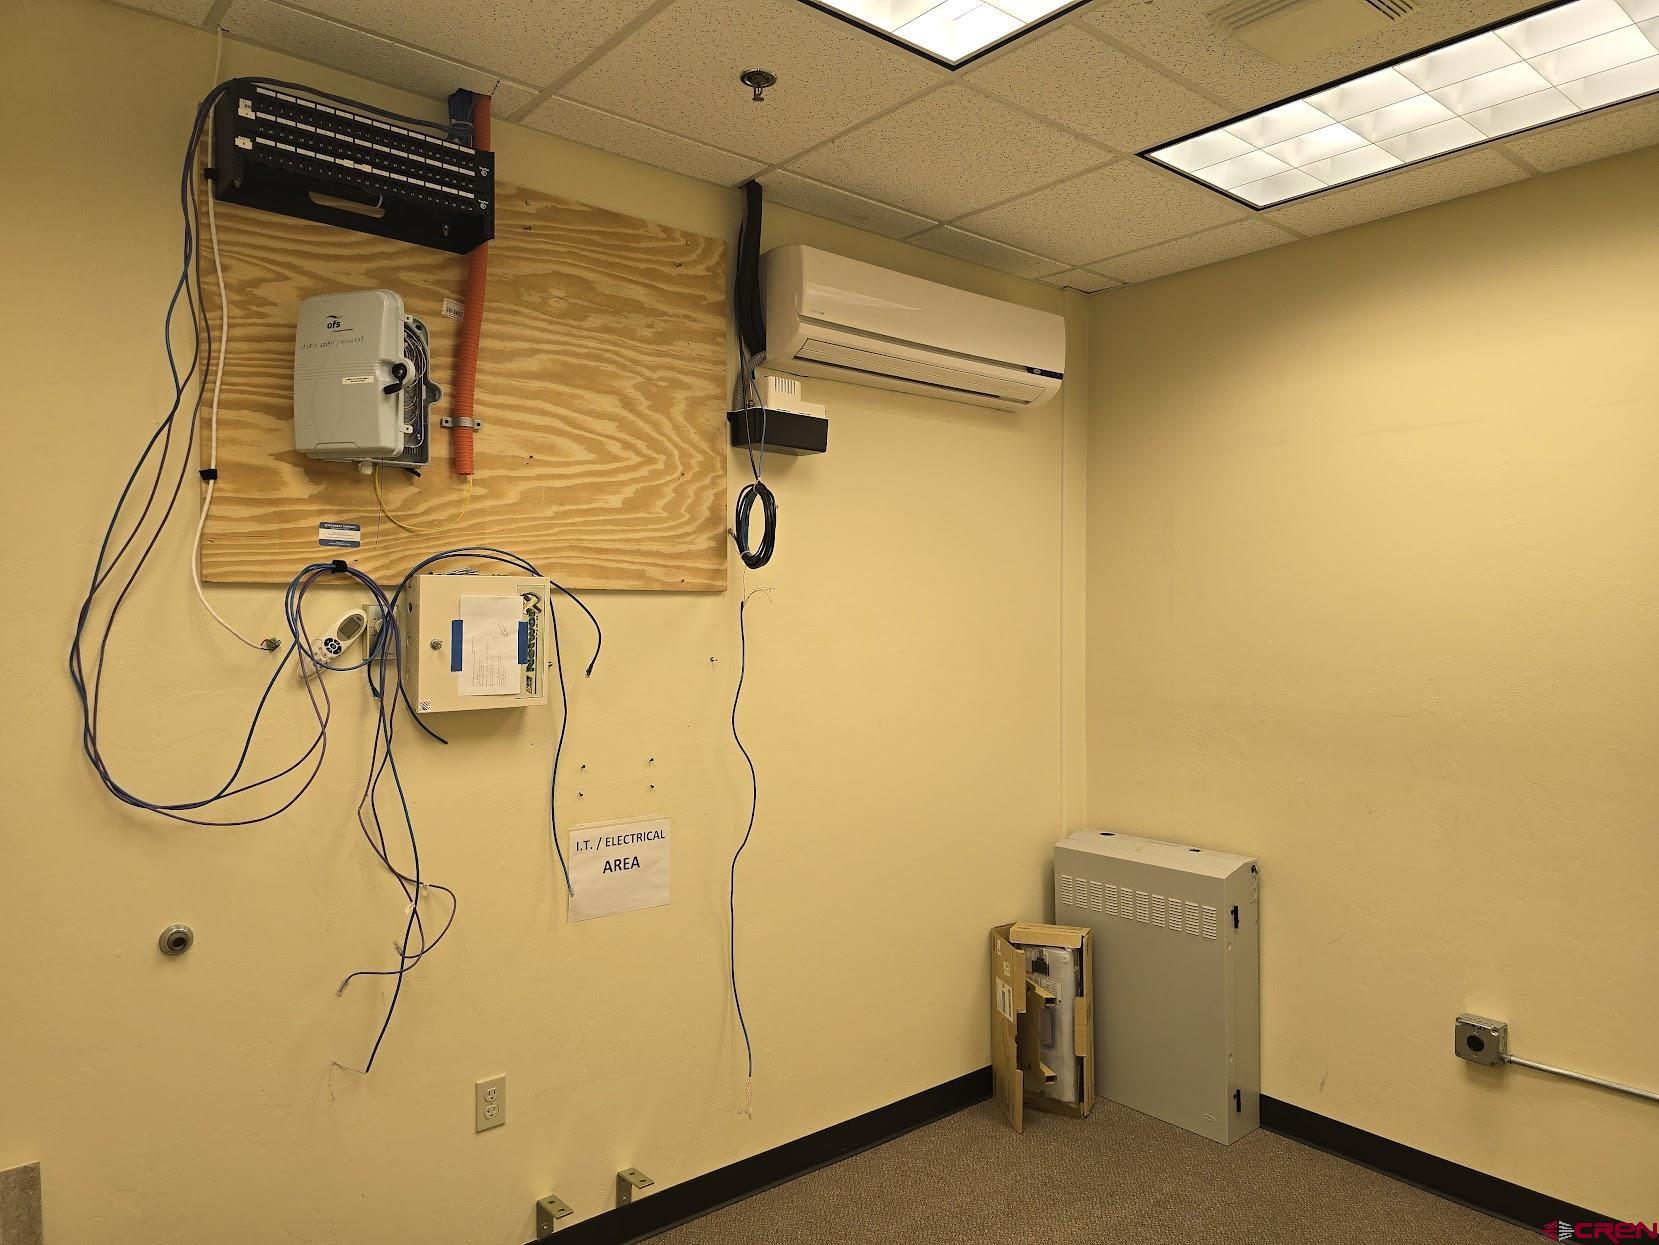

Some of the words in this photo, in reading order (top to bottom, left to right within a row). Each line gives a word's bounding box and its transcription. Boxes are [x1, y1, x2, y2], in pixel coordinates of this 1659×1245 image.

[327, 320, 341, 329] ofs
[576, 839, 593, 852] I.T.
[605, 829, 666, 848] ELECTRICAL
[602, 856, 641, 874] AREA
